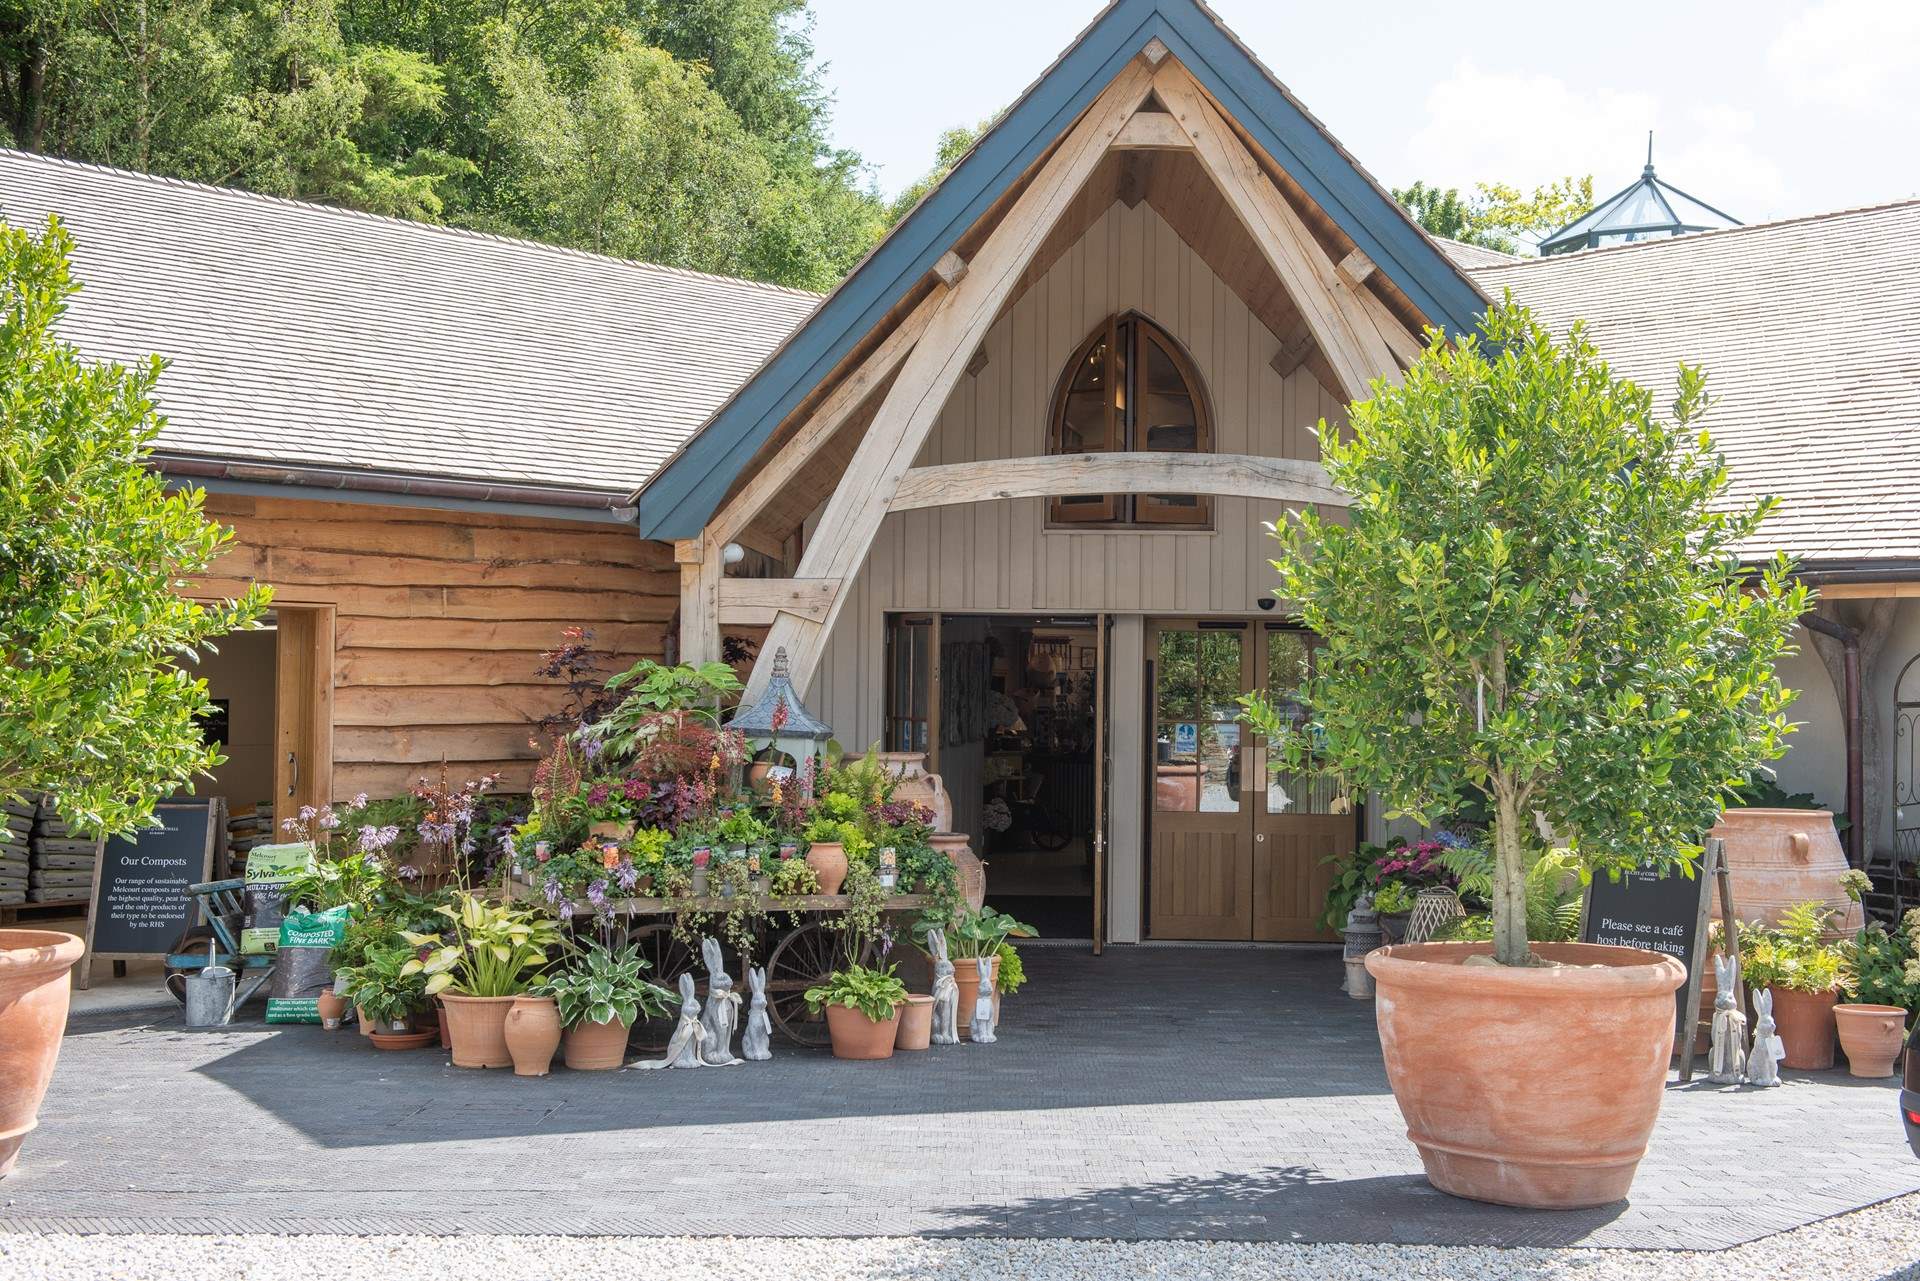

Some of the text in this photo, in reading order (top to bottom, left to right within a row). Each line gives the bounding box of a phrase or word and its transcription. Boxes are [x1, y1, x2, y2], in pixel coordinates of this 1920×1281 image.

[120, 856, 187, 867] Our Composts
[130, 921, 137, 929] by
[1601, 918, 1684, 936] Please see a café
[287, 929, 334, 938] COMPOSTED
[1596, 934, 1685, 956] host before taking
